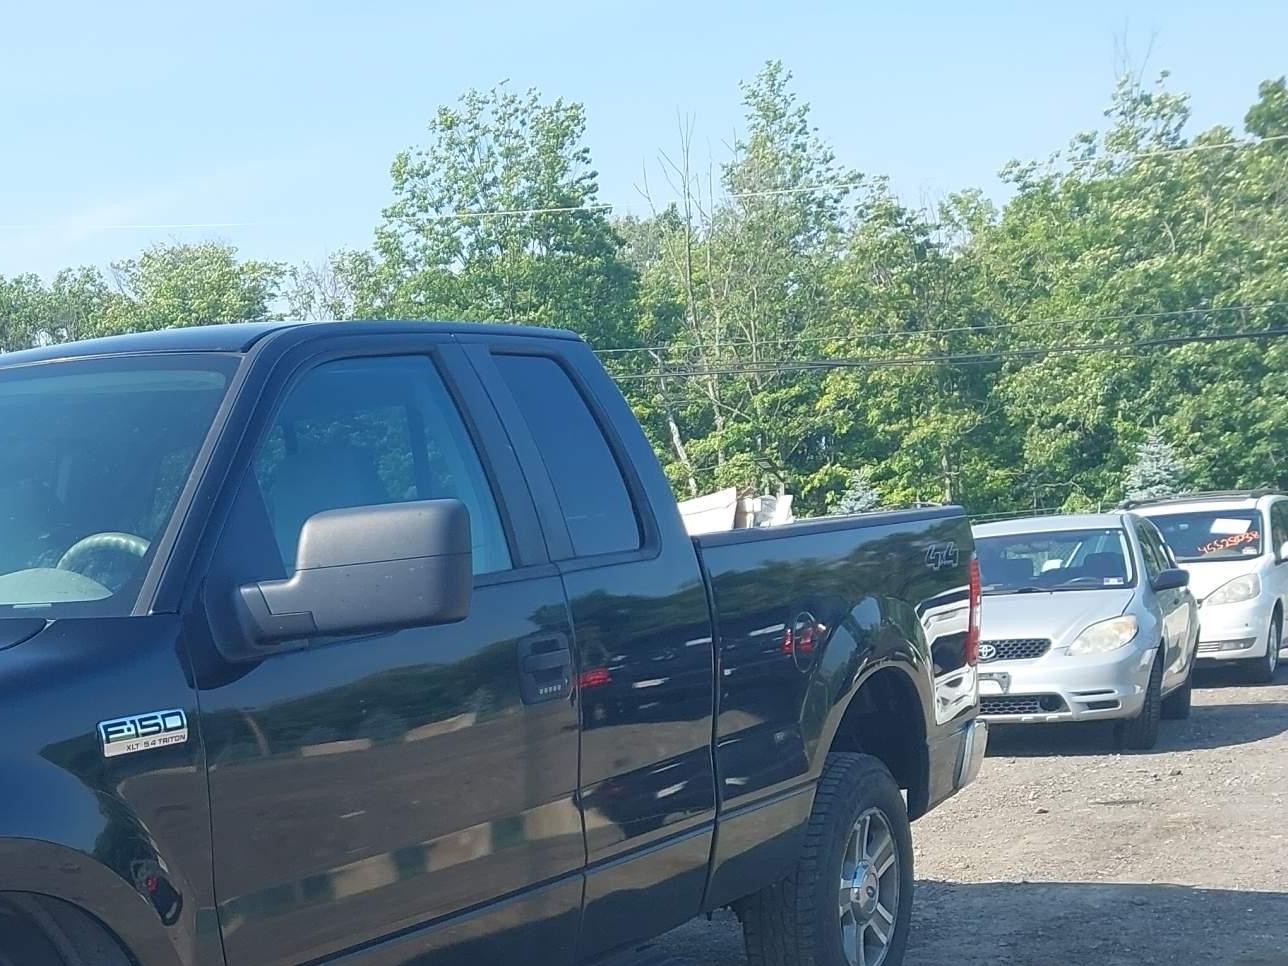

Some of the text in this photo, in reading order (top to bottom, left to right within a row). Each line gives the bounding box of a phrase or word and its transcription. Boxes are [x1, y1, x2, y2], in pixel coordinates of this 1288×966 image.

[925, 542, 959, 570] 4x4
[102, 710, 186, 745] F-150
[125, 742, 140, 752] XLT
[158, 734, 186, 745] TRITON
